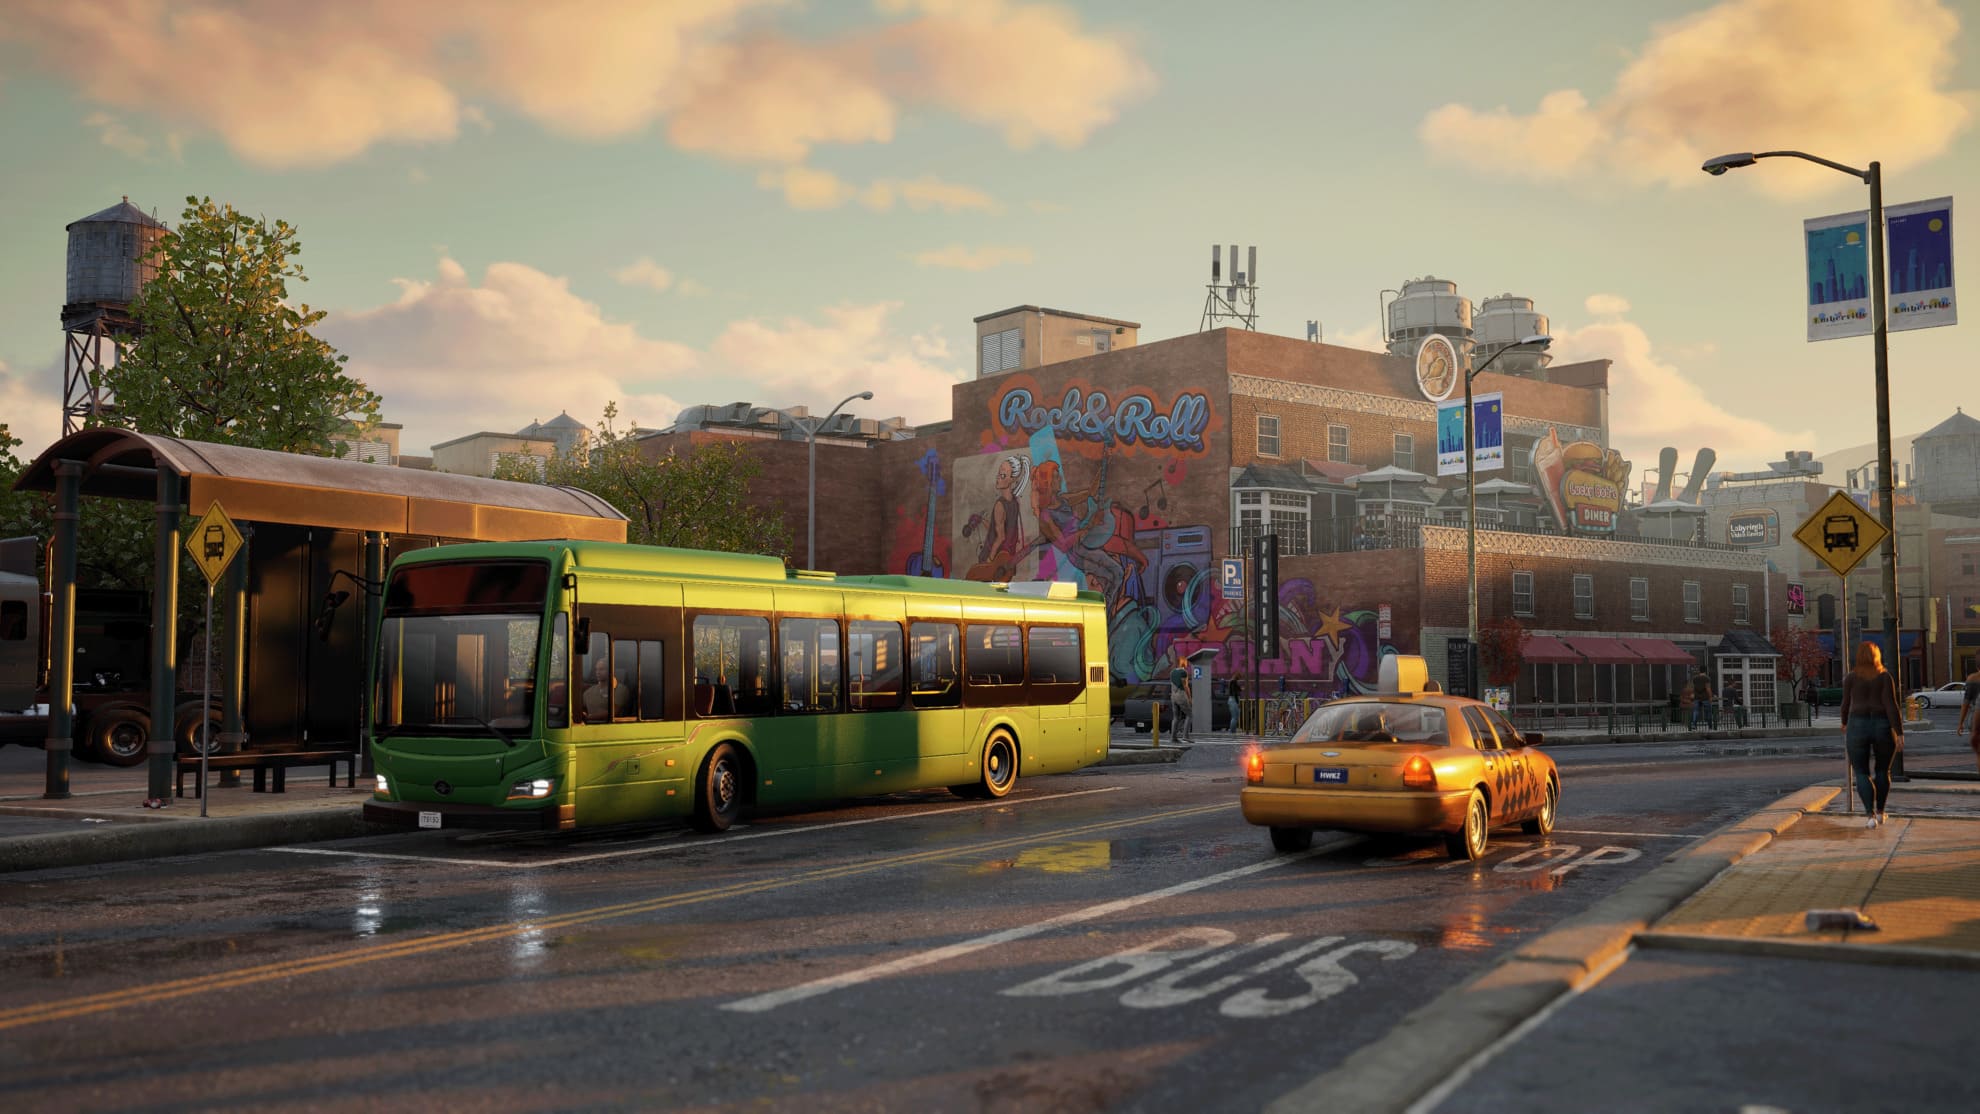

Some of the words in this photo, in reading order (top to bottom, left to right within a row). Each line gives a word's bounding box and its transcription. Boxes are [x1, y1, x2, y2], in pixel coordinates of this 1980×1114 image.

[1584, 509, 1610, 523] DINER
[1225, 564, 1236, 585] P
[1001, 926, 1418, 1018] BUS
